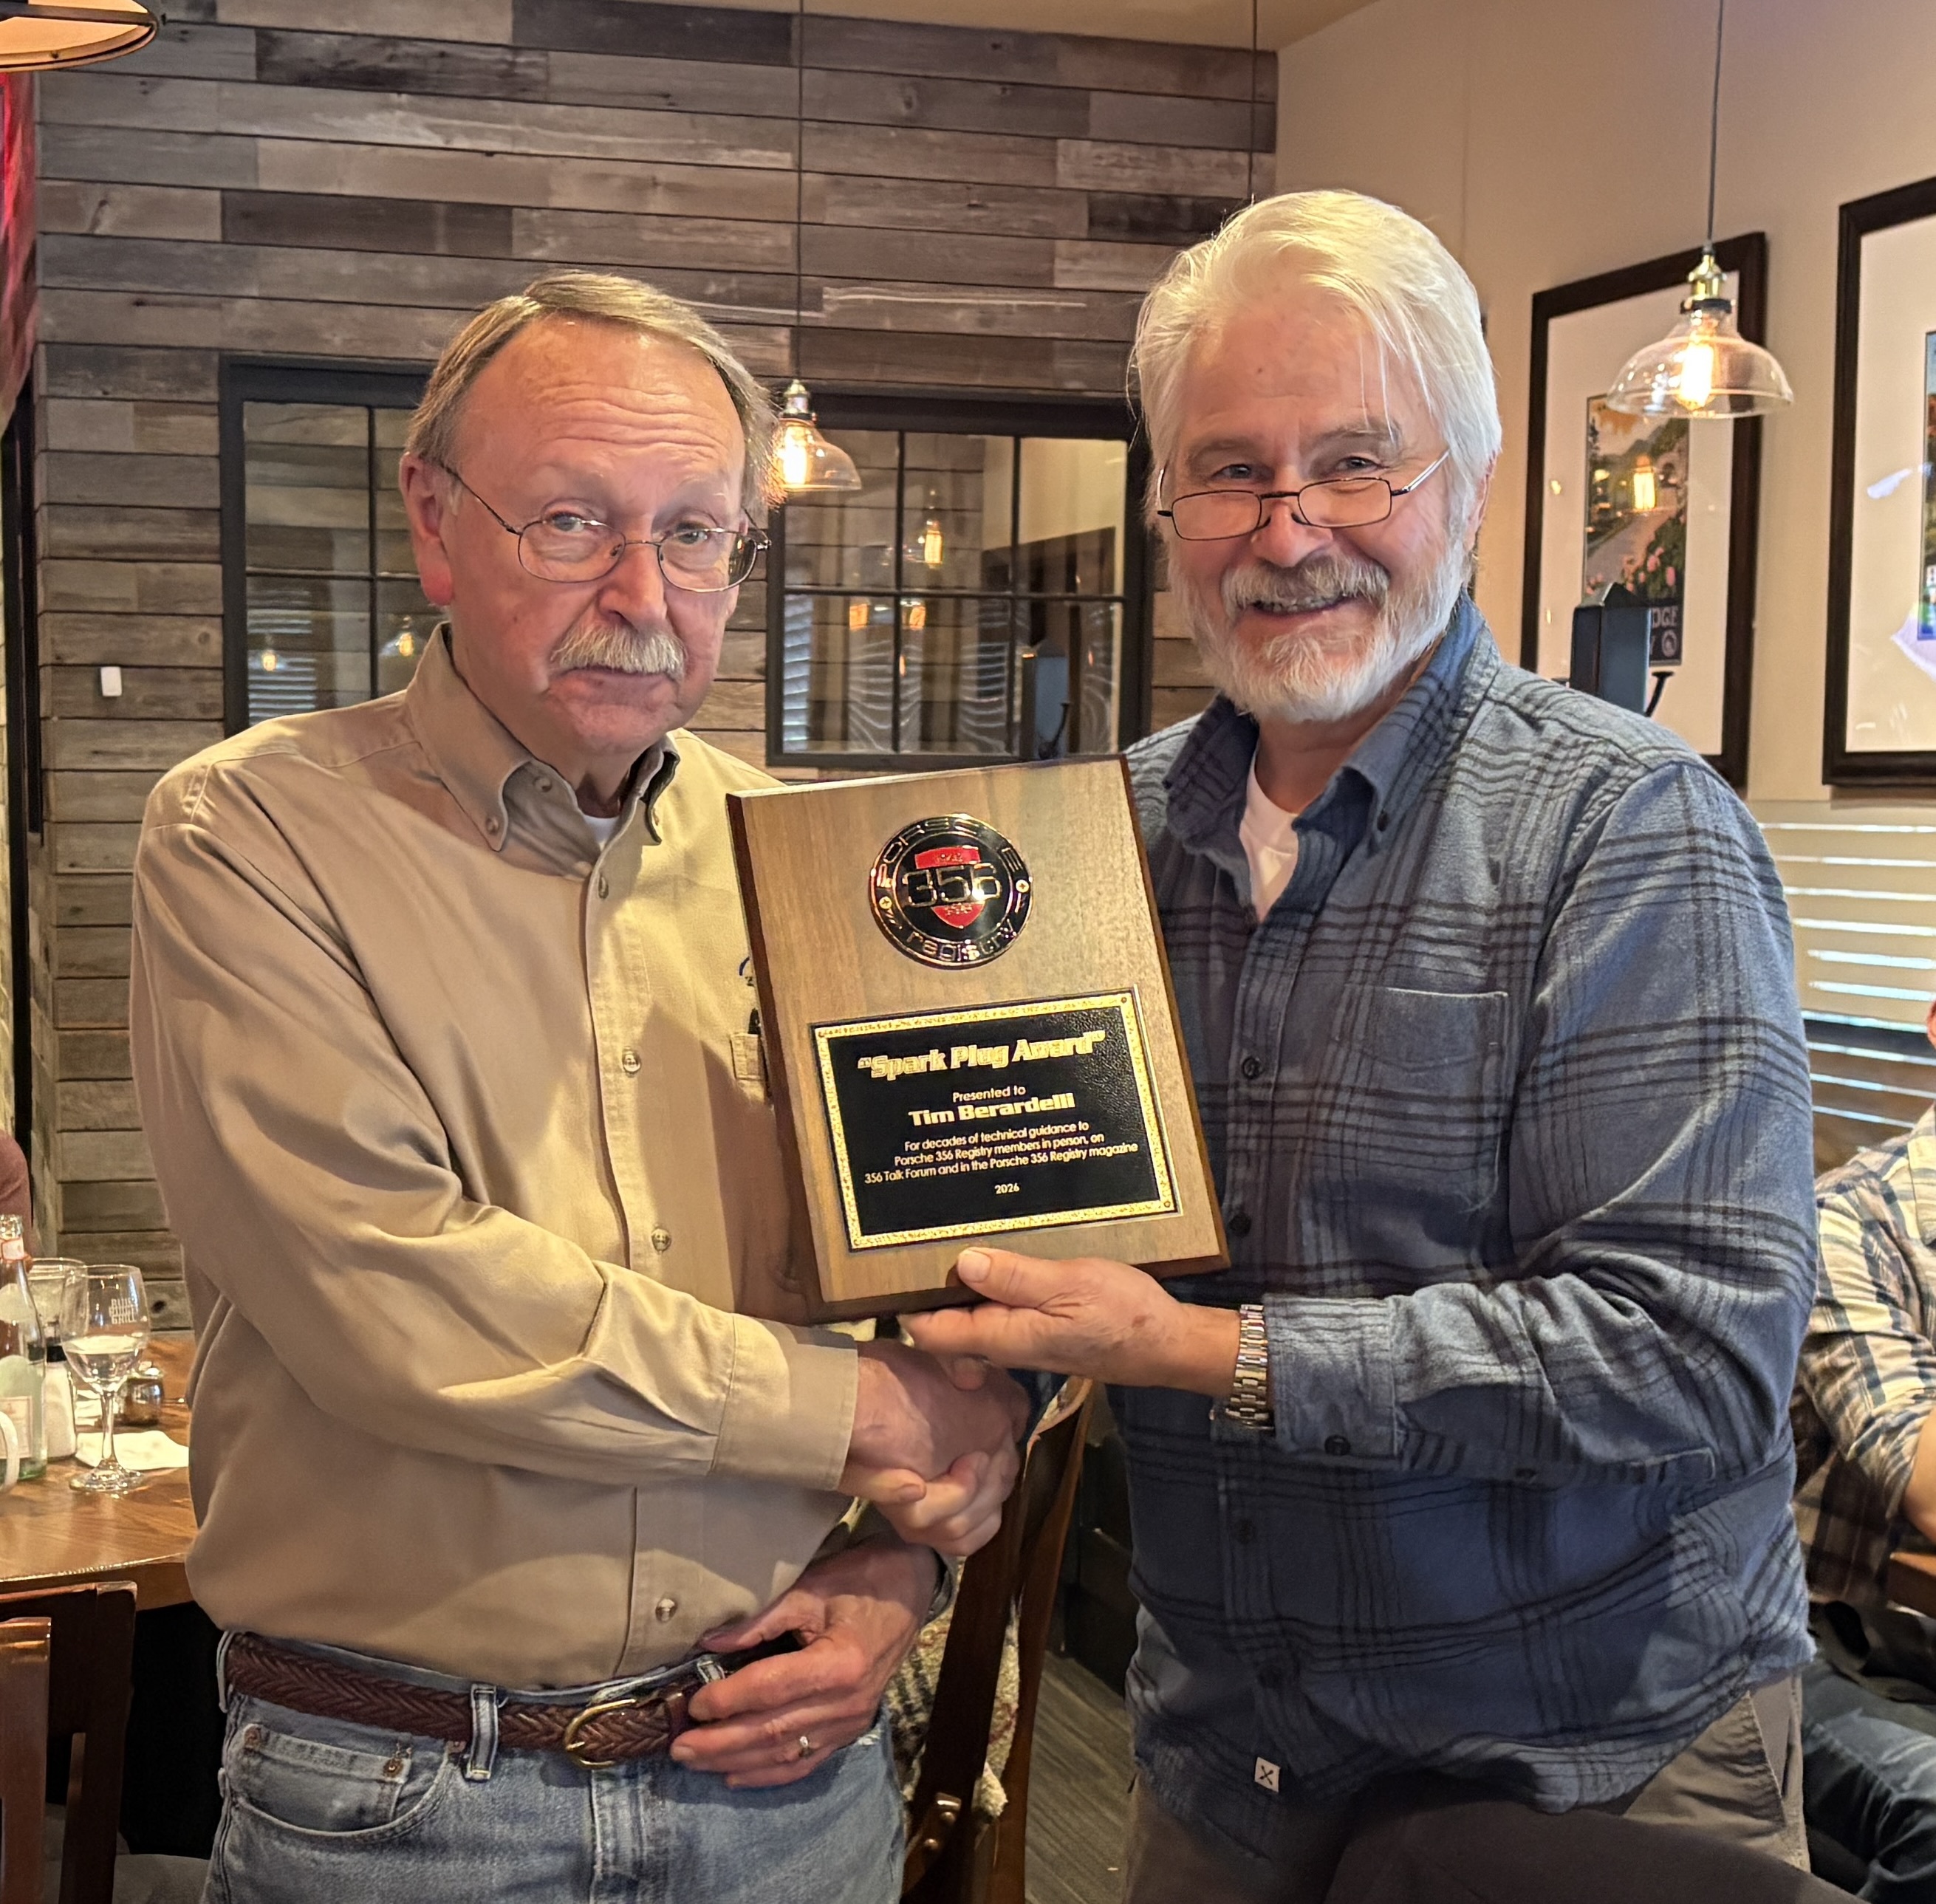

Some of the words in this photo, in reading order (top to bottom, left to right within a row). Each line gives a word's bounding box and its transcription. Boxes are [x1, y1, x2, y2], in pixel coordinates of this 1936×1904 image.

[903, 863, 1002, 908] 356
[950, 1044, 1009, 1069] Plug
[908, 1110, 955, 1126] Tim
[957, 1092, 1076, 1120] Berardelli
[952, 1086, 1010, 1103] Presented
[1013, 1085, 1026, 1095] to
[894, 1153, 934, 1166] Porsche
[935, 1151, 954, 1162] 356
[955, 1146, 993, 1160] Registry
[993, 1140, 1041, 1154] members
[1041, 1138, 1051, 1148] in
[1090, 1133, 1105, 1143] on
[904, 1141, 921, 1151] For
[922, 1135, 966, 1149] decades
[968, 1132, 979, 1144] of
[980, 1127, 1027, 1143] technical
[1029, 1123, 1076, 1139] guidance
[1078, 1121, 1090, 1131] to
[864, 1173, 883, 1184] 356
[883, 1170, 905, 1182] Talk
[905, 1167, 937, 1179] Forum
[937, 1163, 959, 1175] and
[960, 1161, 970, 1172] in
[971, 1160, 988, 1171] the
[990, 1155, 1029, 1168] Porsche
[1030, 1153, 1049, 1164] 356
[1050, 1148, 1087, 1162] Registry
[1089, 1143, 1138, 1157] magazine
[994, 1182, 1020, 1194] 2026
